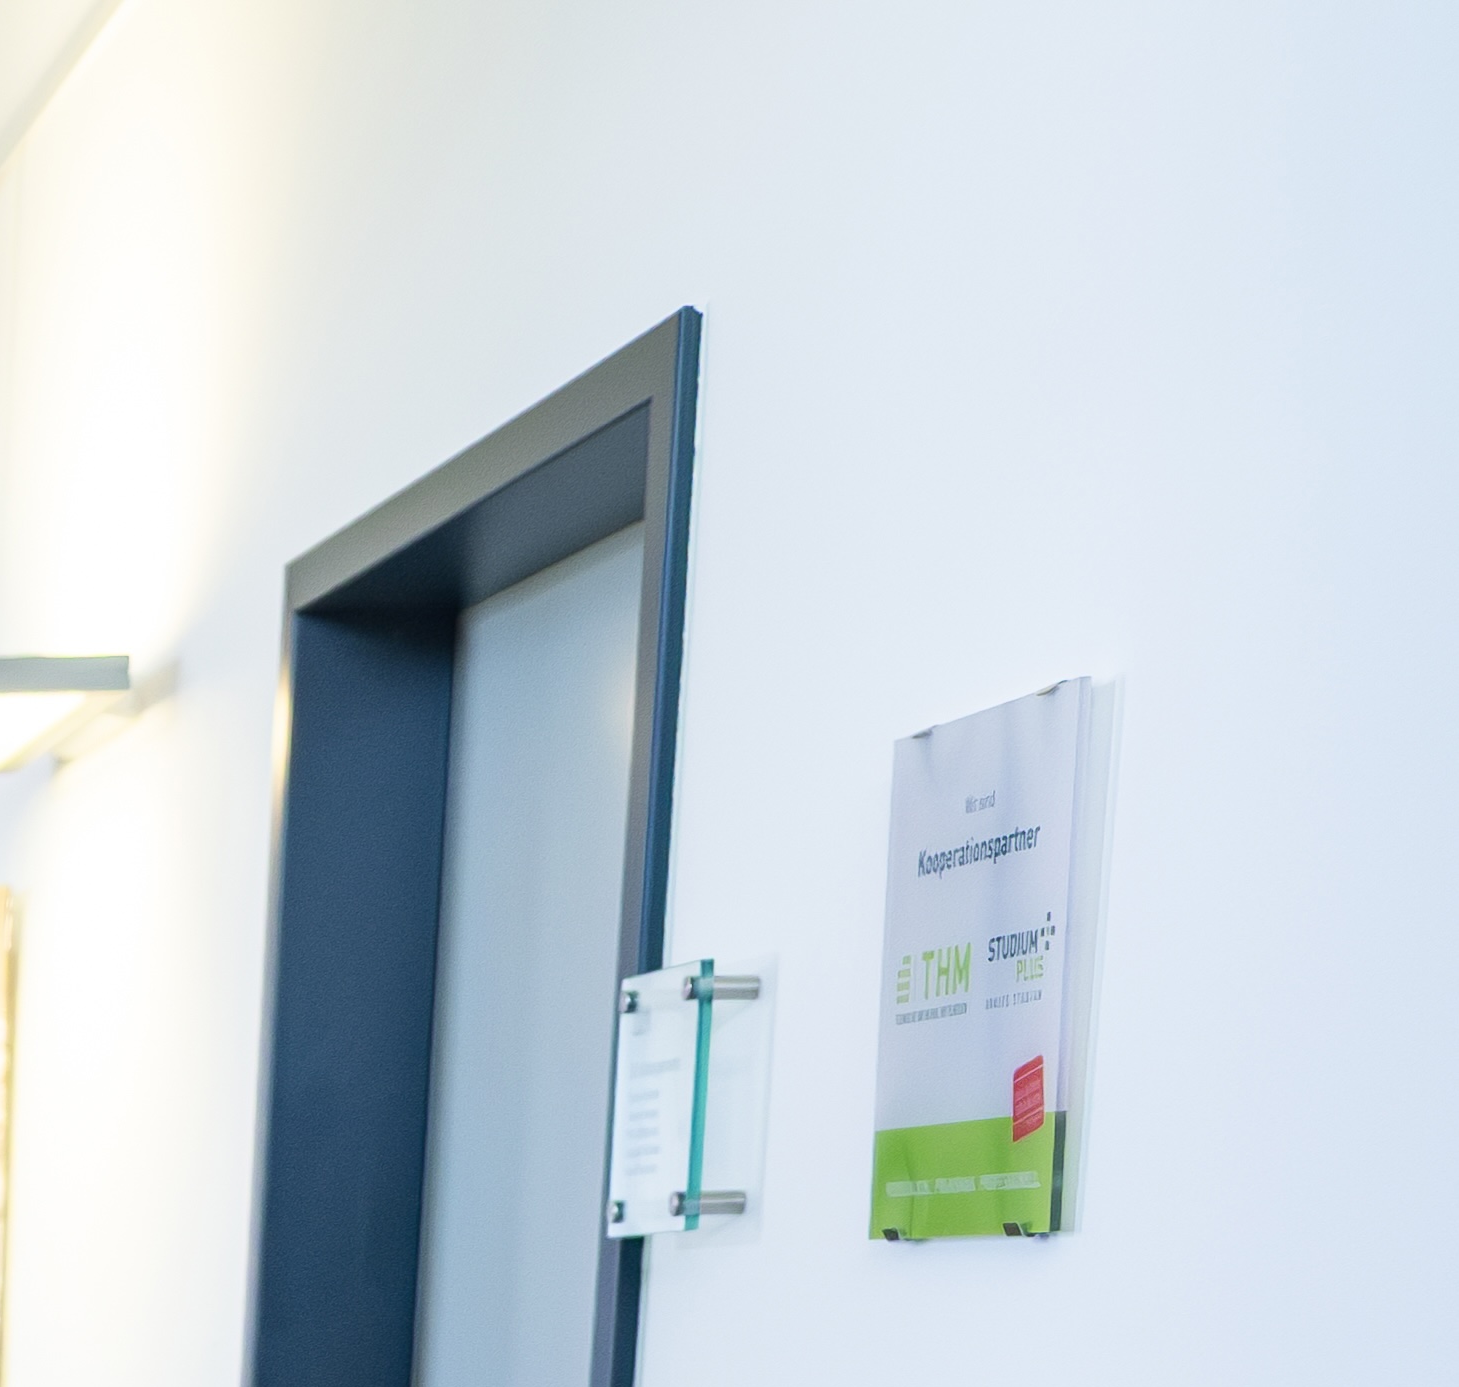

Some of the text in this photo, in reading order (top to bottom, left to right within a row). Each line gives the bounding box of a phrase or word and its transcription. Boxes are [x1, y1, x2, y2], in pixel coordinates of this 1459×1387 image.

[918, 825, 1041, 879] Kooperationspartner
[988, 929, 1039, 962] STUDIUM
[922, 942, 971, 1000] THM
[1016, 955, 1044, 983] PLUS
